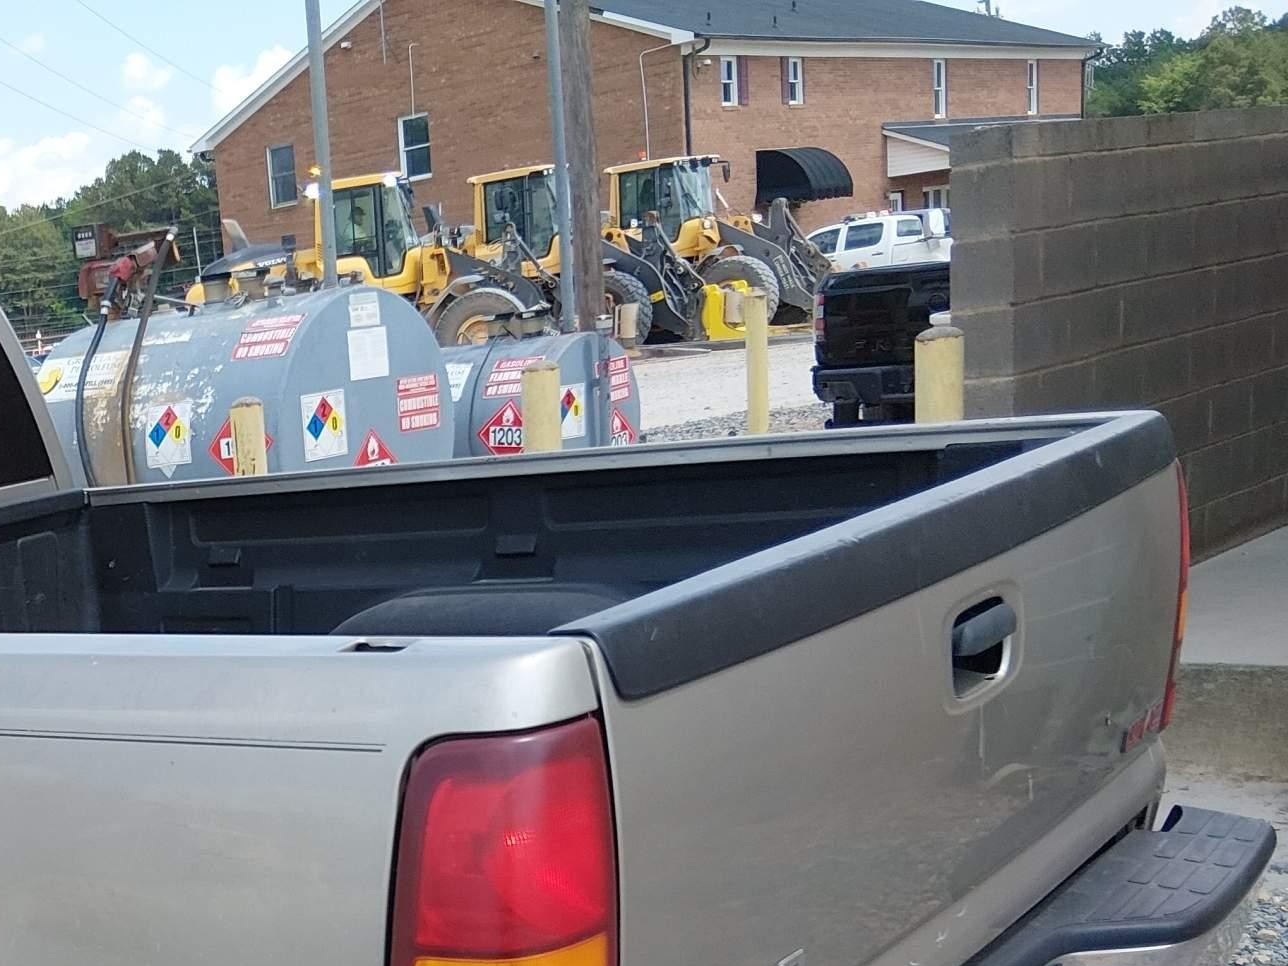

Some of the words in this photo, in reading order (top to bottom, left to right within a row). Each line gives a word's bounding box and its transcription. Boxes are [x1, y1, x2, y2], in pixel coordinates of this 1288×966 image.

[248, 341, 287, 357] SMOKING
[321, 402, 327, 418] 2
[164, 412, 171, 426] 2
[332, 416, 338, 431] 0
[175, 425, 181, 439] 0
[491, 427, 522, 446] 1203
